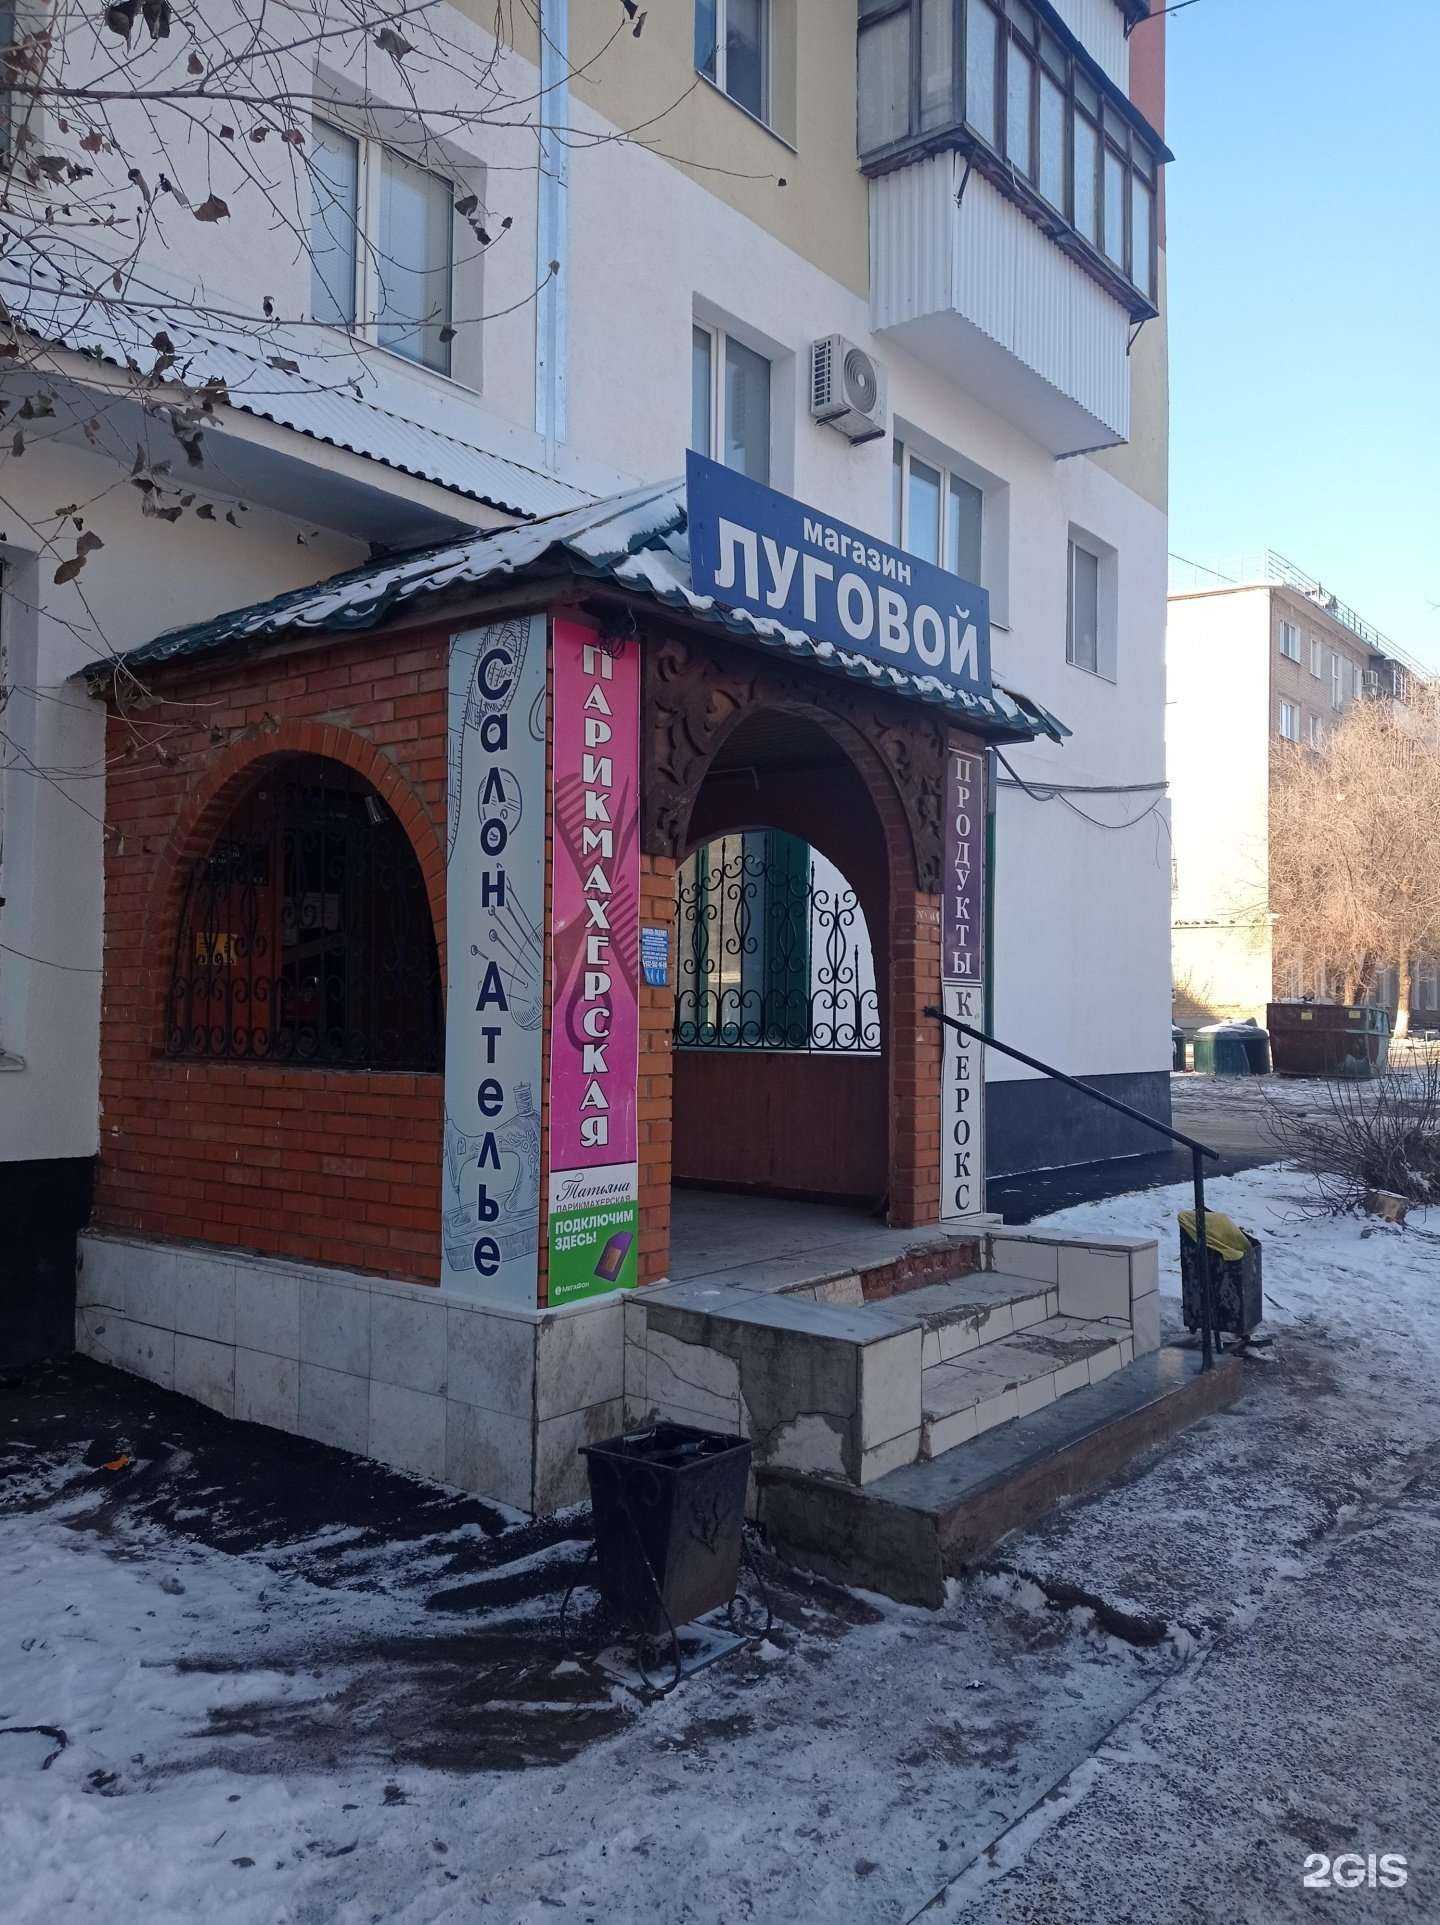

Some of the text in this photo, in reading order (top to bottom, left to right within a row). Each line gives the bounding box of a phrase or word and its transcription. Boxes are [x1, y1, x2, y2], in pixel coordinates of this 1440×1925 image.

[714, 517, 979, 681] ЛУГОВОЙ
[803, 517, 912, 586] магазин
[580, 644, 613, 1148] ПАРИКМАХЕРСКАЯ
[952, 758, 973, 975] ПРОДУКТЫ
[473, 648, 513, 1277] Салон Ателье
[953, 991, 973, 1210] КСЕРОКС
[555, 1210, 633, 1234] ПОДКЛЮЧИМ
[555, 1232, 597, 1251] ЗДЕСЬ!
[556, 1173, 631, 1201] Татьяна
